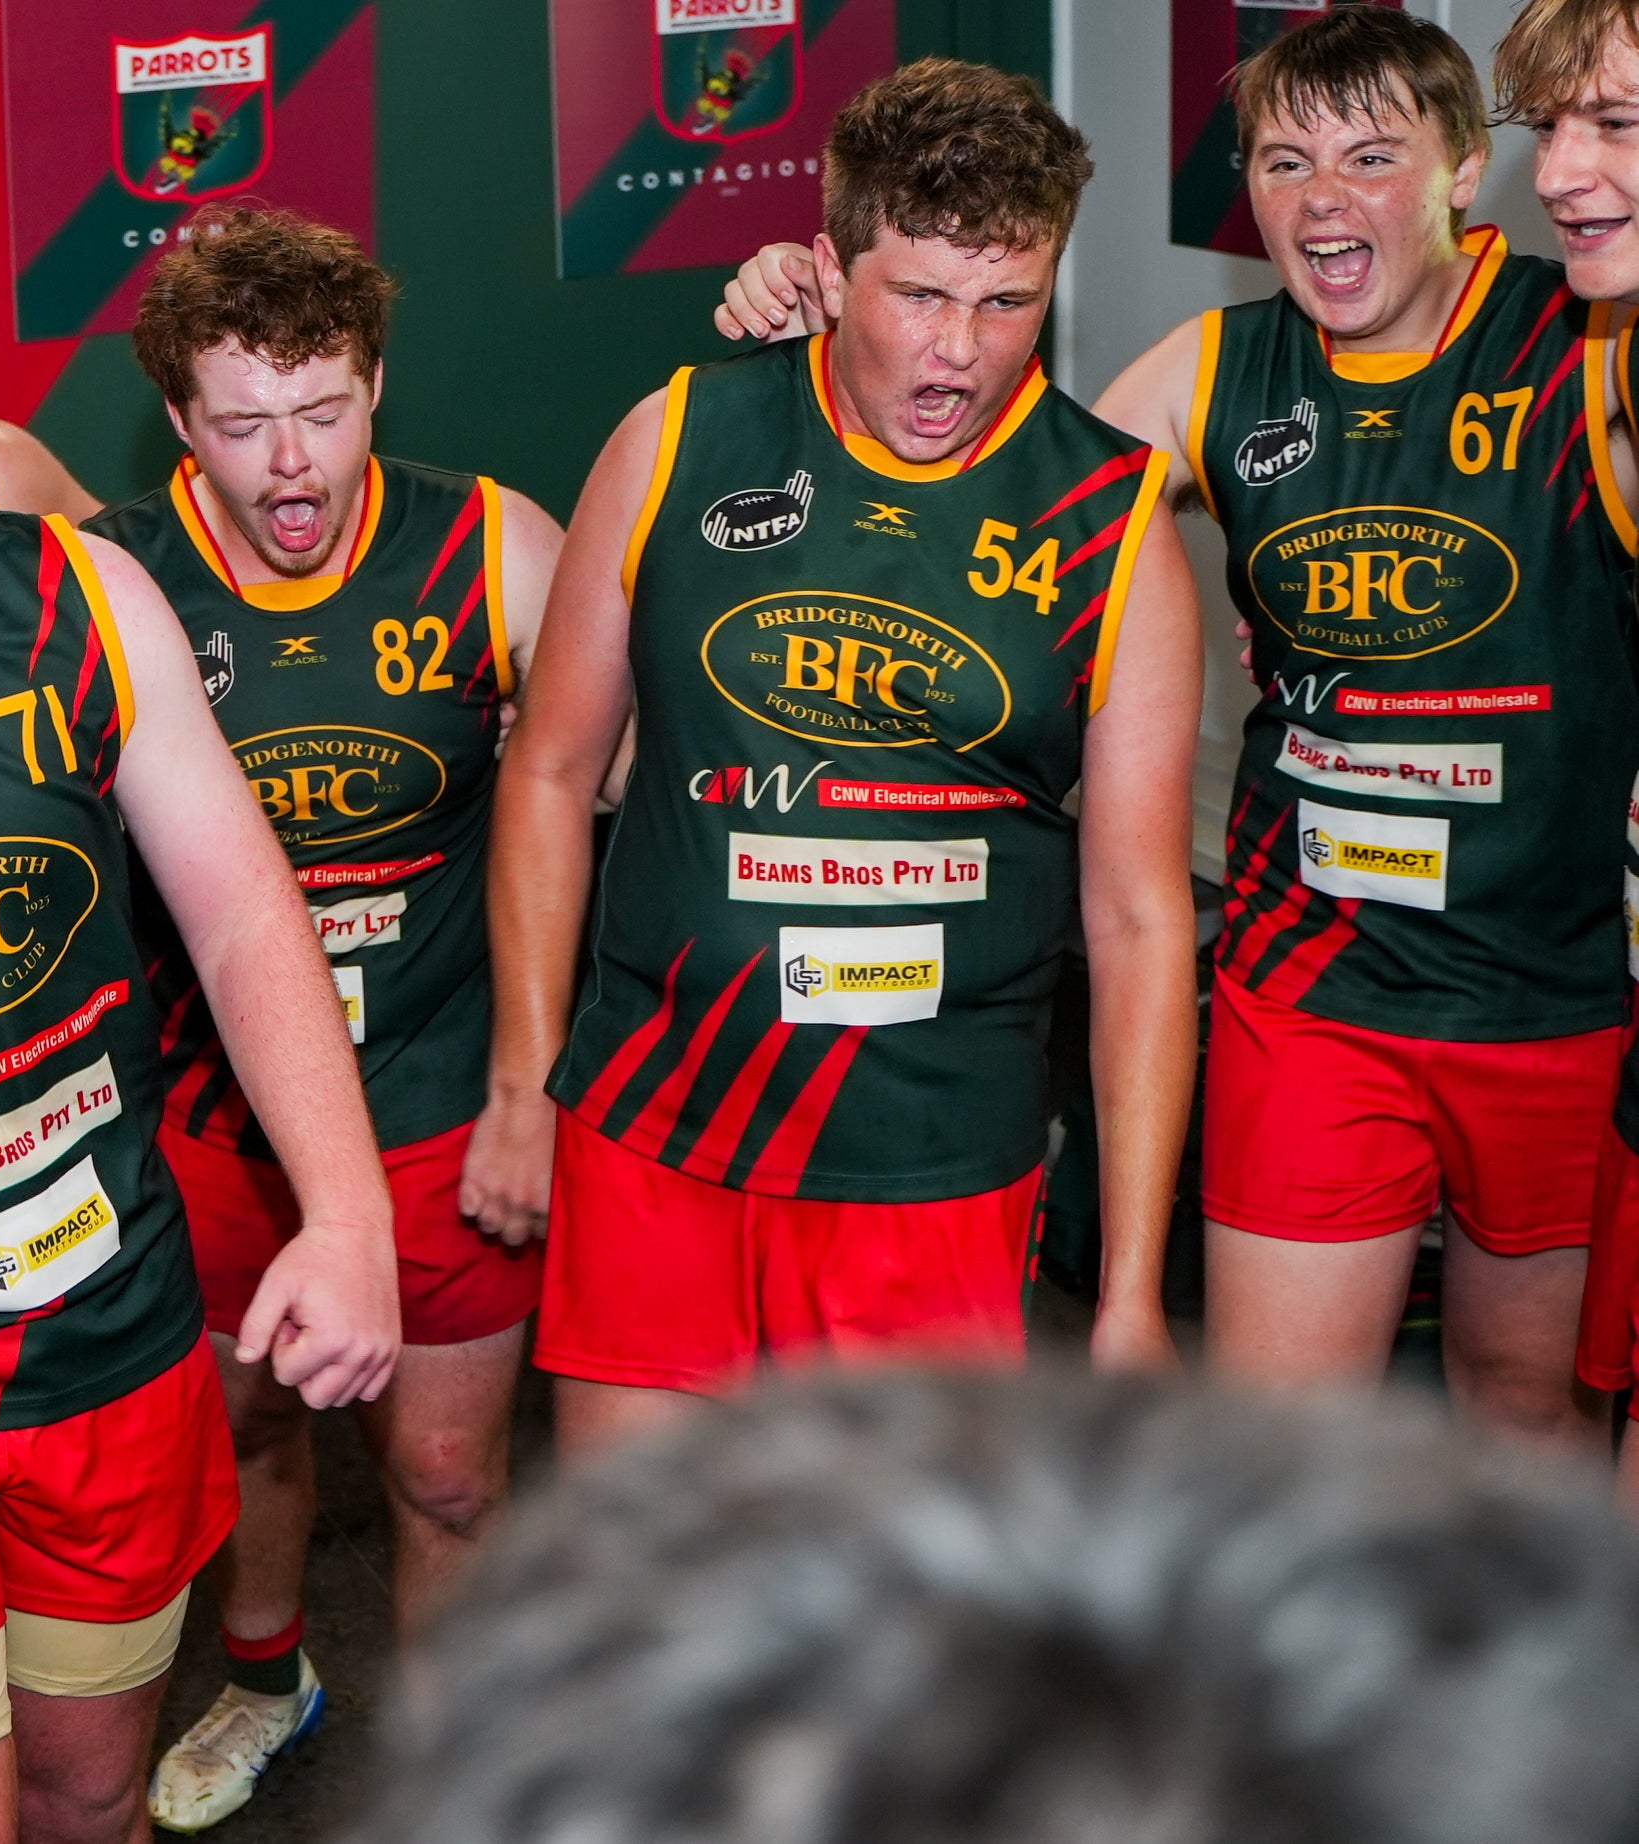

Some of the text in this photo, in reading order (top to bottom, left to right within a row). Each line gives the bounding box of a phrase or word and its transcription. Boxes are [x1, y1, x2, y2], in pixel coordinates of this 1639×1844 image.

[131, 46, 251, 78] PARROTS
[617, 157, 818, 192] CONTAGIOU
[1344, 429, 1404, 440] XBLADES
[1449, 386, 1534, 475] 67
[1253, 438, 1310, 478] NTFA
[732, 512, 801, 544] NTFA
[853, 519, 917, 539] XBLADES
[1276, 522, 1467, 561] BRIDGENORTH
[967, 518, 1061, 615] 54
[1302, 550, 1442, 620] BFC
[754, 606, 968, 672] BRIDGENORTH
[1296, 615, 1449, 647] OOTBALL CLUB
[269, 654, 328, 668] XBLADES
[372, 615, 454, 696] 82
[204, 670, 230, 697] FA
[750, 633, 956, 716] EST. BFC 1925
[764, 692, 877, 732] FOOTBALL
[1344, 692, 1538, 711] CNW Electrical Wholesale
[235, 740, 402, 772] RIDGENORTH
[1399, 764, 1441, 785] PTY
[1451, 763, 1492, 787] LTD
[248, 764, 380, 822] BFC
[830, 786, 1018, 806] CNW Electrical Wholesale
[738, 854, 979, 886] BEAMS BROS PTY LTD
[1344, 845, 1434, 867] IMPACT
[314, 868, 377, 883] Electrical
[320, 918, 357, 938] PTY
[1, 941, 46, 989] CLUB
[840, 964, 932, 981] IMPACT
[11, 1026, 69, 1069] Electrical
[71, 988, 117, 1034] Wholesale
[40, 1105, 70, 1140] PTY
[76, 1084, 112, 1115] LTD
[29, 1199, 100, 1258] IMPACT
